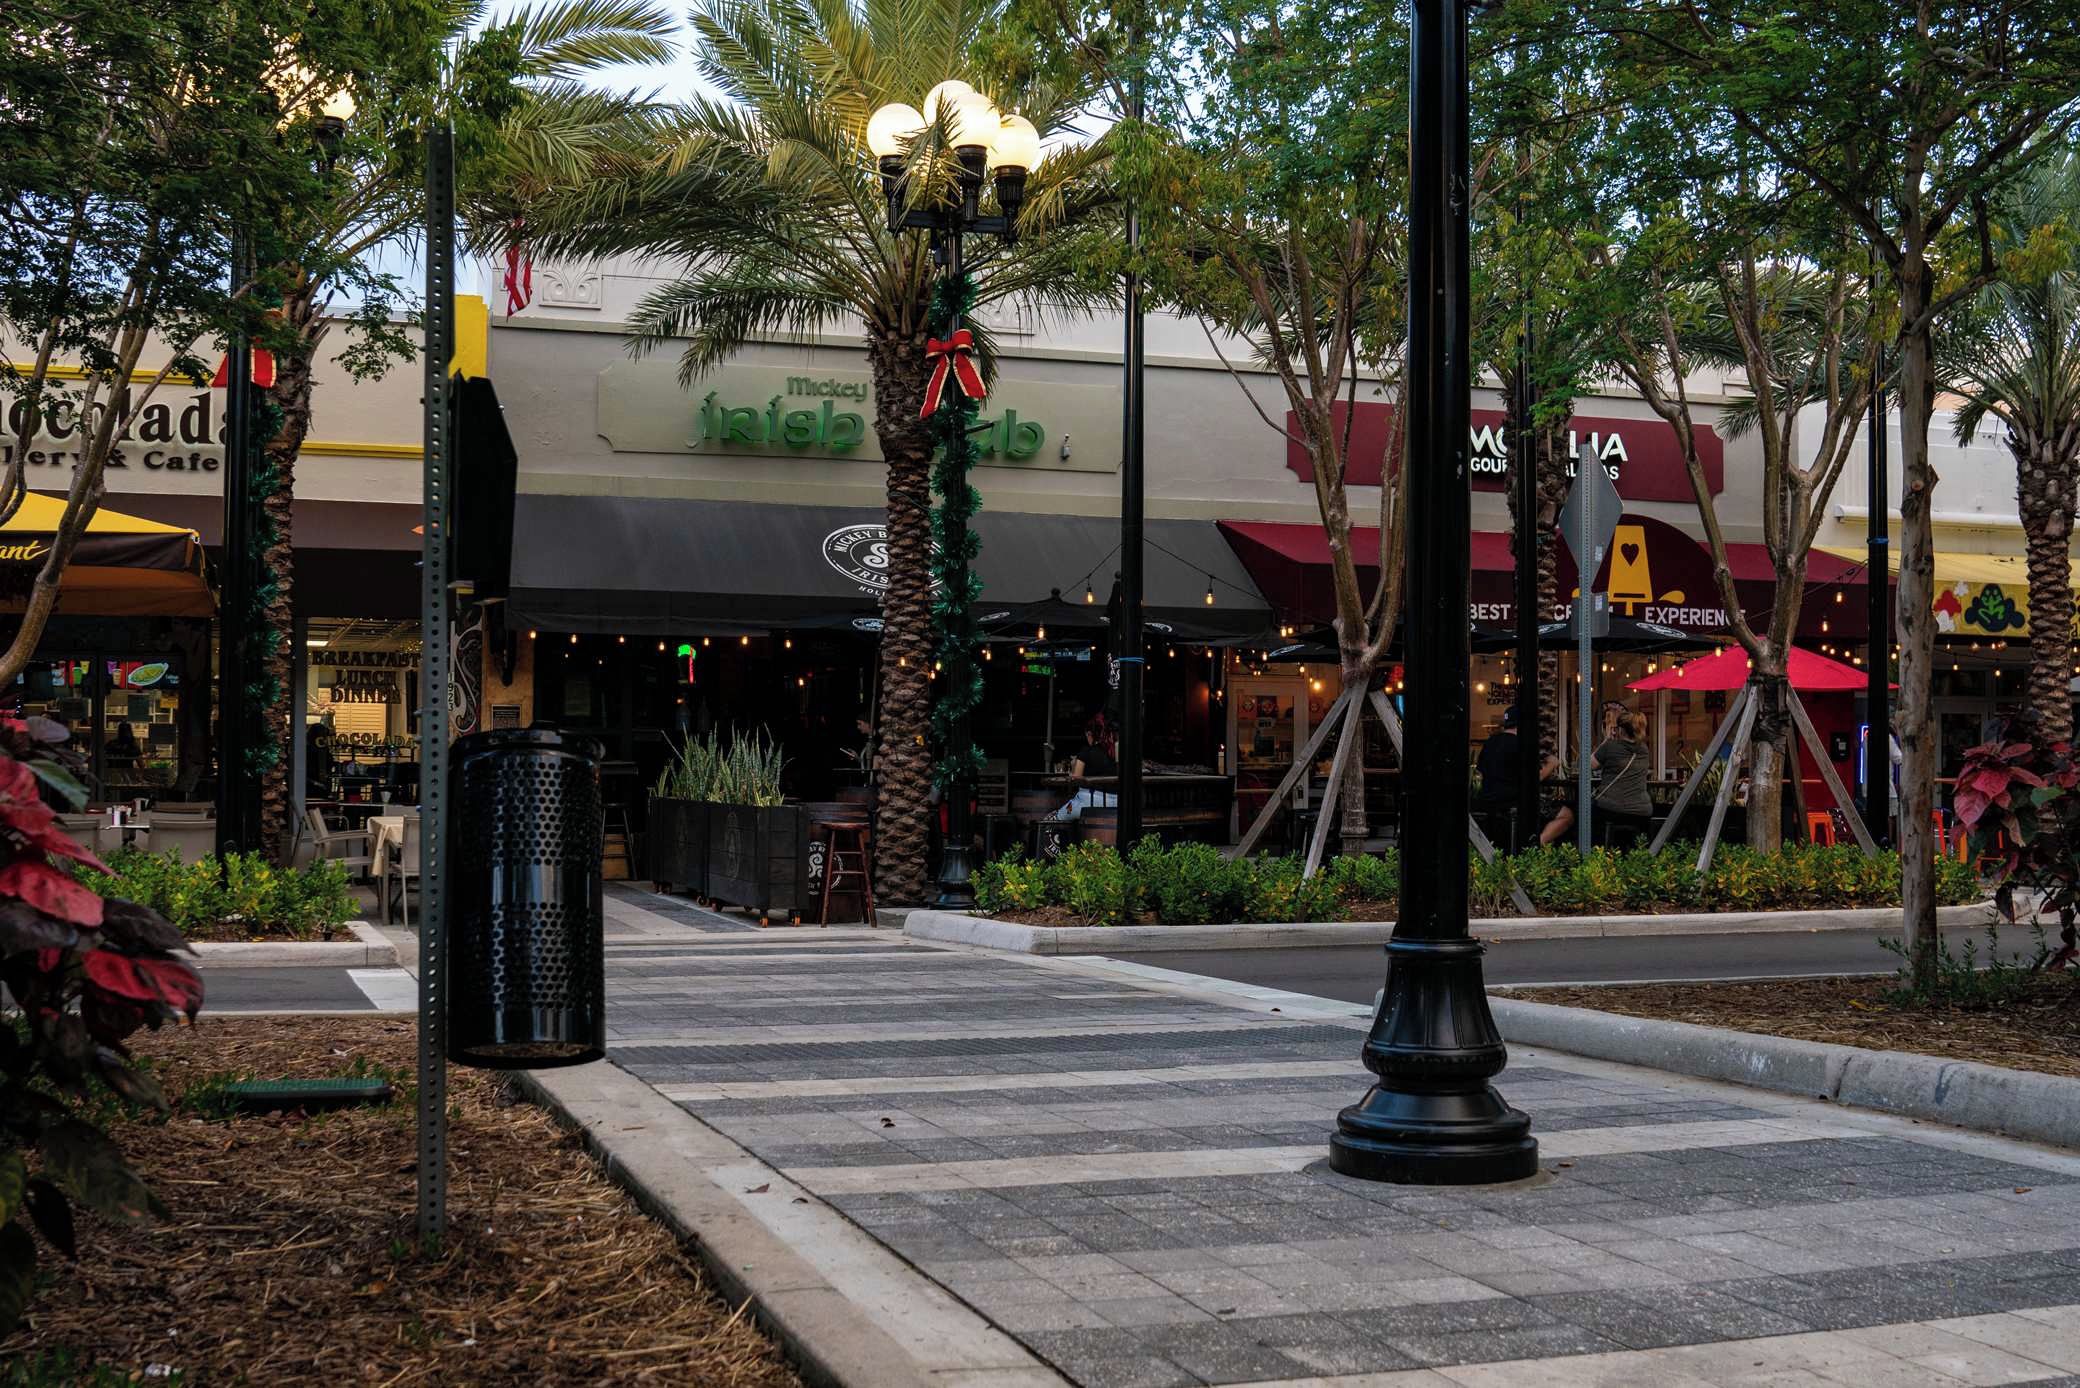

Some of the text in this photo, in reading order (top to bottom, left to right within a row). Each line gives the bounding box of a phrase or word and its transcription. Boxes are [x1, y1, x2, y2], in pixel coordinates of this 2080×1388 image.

[786, 376, 868, 402] Mickey
[143, 451, 220, 471] Cafe
[833, 530, 872, 553] MICKEY
[851, 567, 888, 584] IRIS
[1470, 604, 1511, 621] BEST
